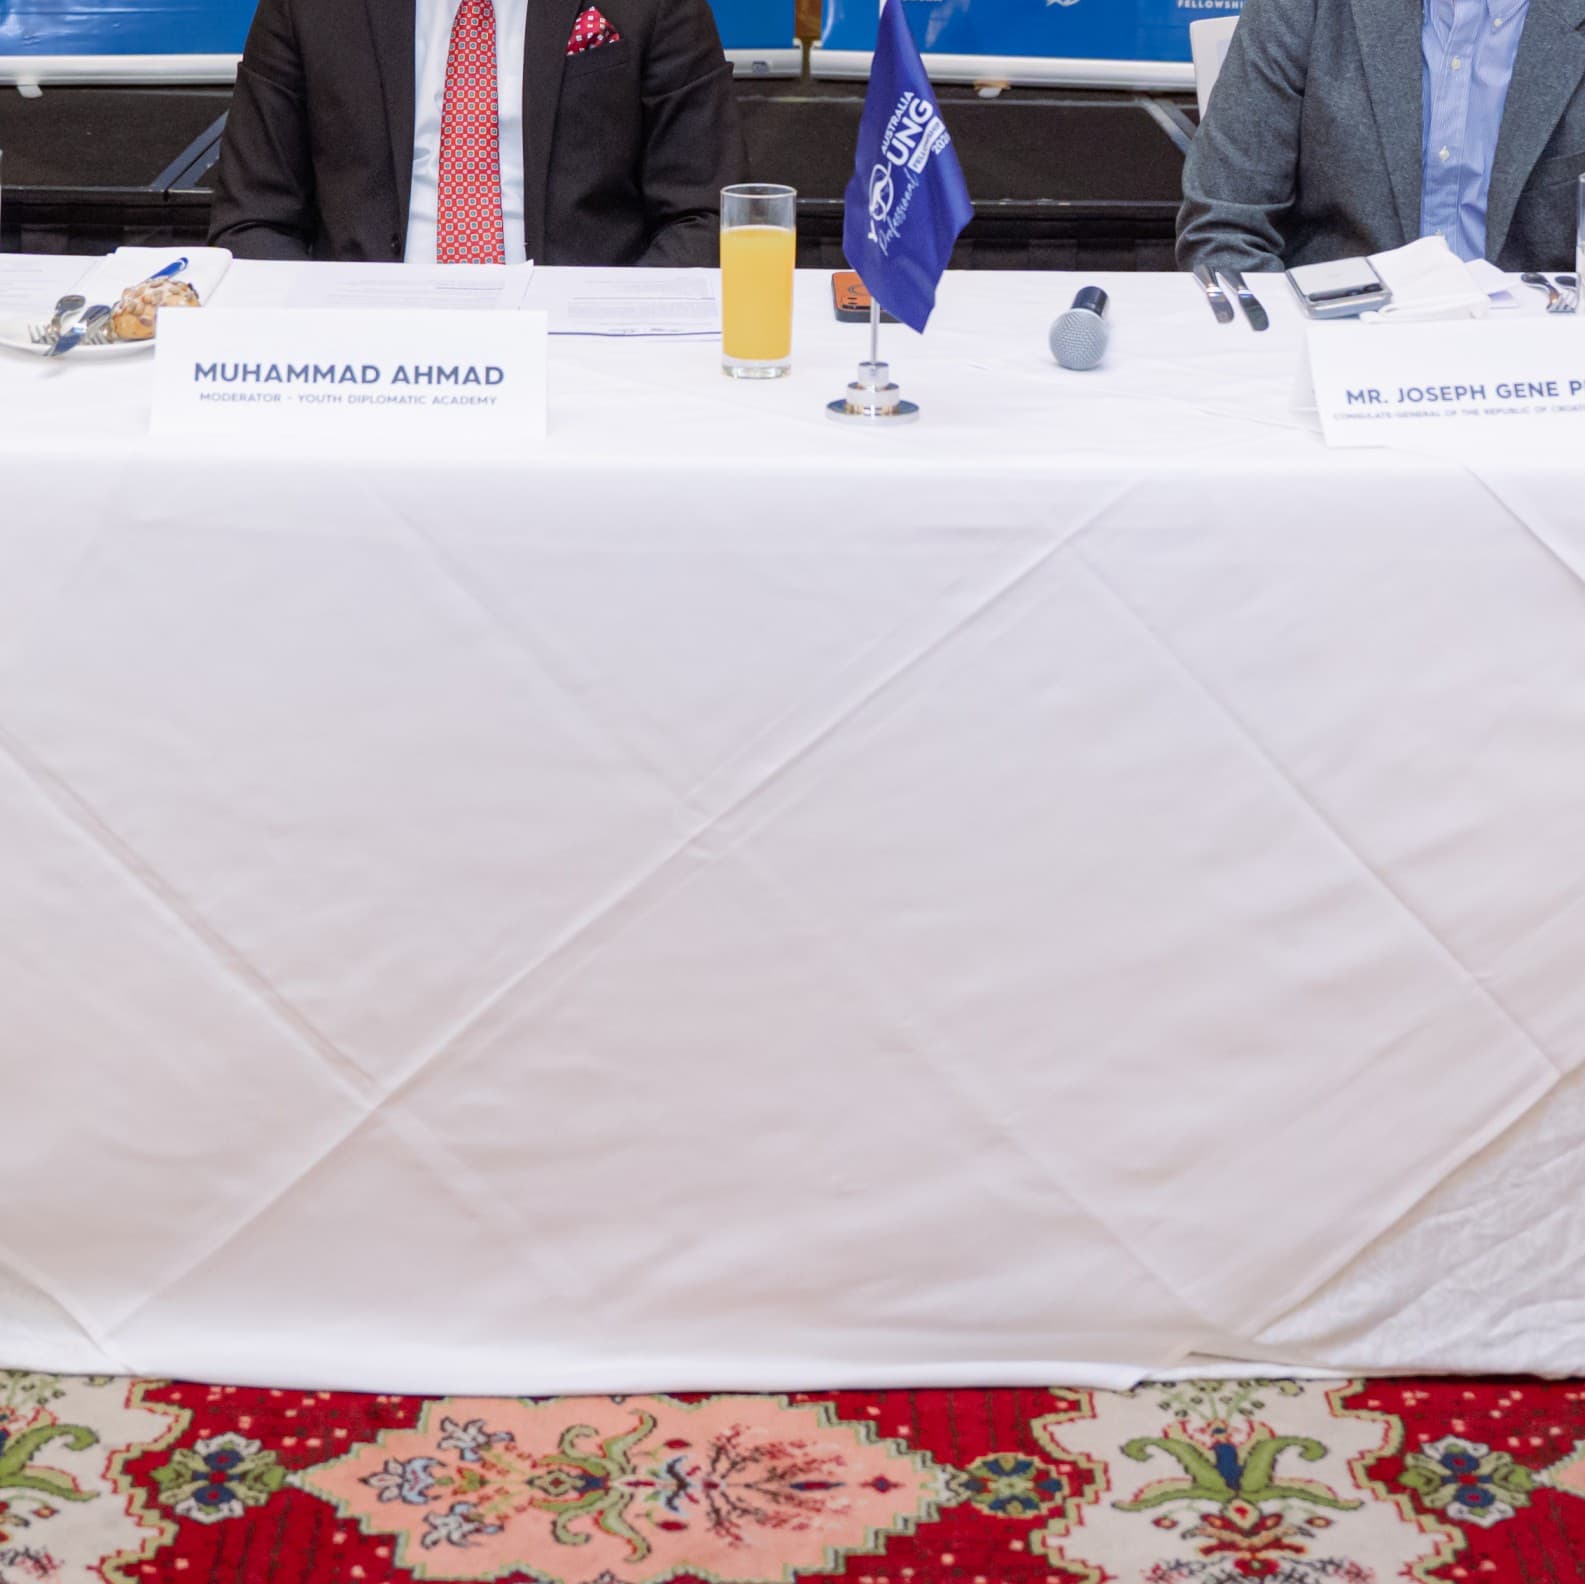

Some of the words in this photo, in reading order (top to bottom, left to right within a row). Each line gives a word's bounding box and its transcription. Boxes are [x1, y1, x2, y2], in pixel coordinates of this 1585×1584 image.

[881, 91, 915, 155] AUSTRALIA
[194, 362, 381, 385] MUHAMMAD
[391, 365, 505, 386] AHMAD
[199, 391, 282, 403] MODERATOR
[298, 393, 342, 404] YOUTH
[347, 394, 426, 405] DIPLOMATIC
[431, 395, 497, 406] ACADEMY
[1346, 389, 1389, 405] MR.
[1397, 385, 1487, 403] JOSEPH
[1496, 380, 1560, 399] GENE
